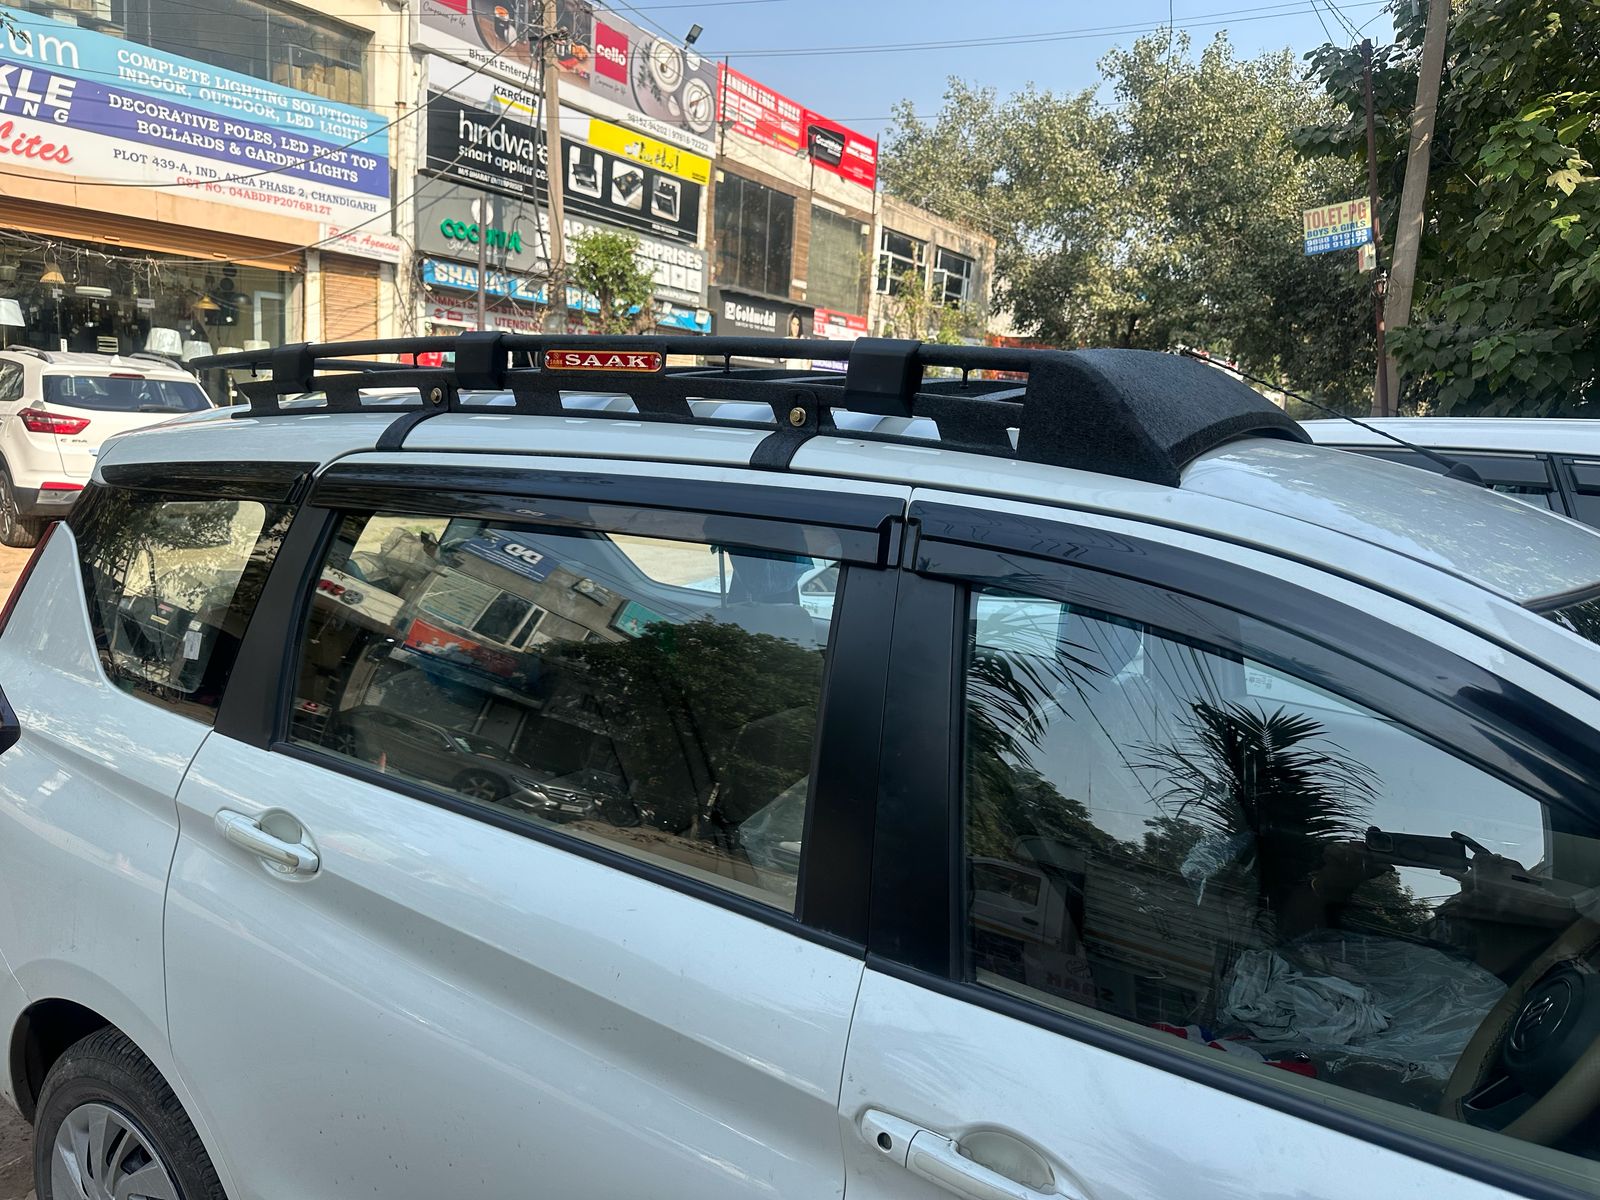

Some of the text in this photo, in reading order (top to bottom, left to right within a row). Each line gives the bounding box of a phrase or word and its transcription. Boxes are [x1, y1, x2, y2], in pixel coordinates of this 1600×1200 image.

[596, 44, 626, 66] cello
[117, 50, 368, 130] COMPLETE LIGHTING SOLUTIONS
[117, 65, 369, 144] INDOOR, OUTDOOR, LED LIGHTS
[108, 93, 377, 171] DECORATIVE POLES, LED POST TOP
[136, 119, 359, 183] BOLLARDS & GARDEN LIGHTS
[113, 148, 148, 164] PLOT
[152, 157, 193, 176] 439-A,
[225, 172, 256, 189] AREA
[259, 179, 296, 196] PHASE
[298, 187, 308, 199] 2,
[311, 191, 377, 213] CHANDIGARH
[176, 176, 201, 189] GST
[205, 182, 226, 195] NO.
[1304, 201, 1367, 230] TOLET-PG
[1307, 220, 1366, 238] BOYS & GIRLS
[361, 234, 400, 252] Agencies
[735, 304, 776, 327] Goldmedal
[565, 353, 649, 368] SAAK
